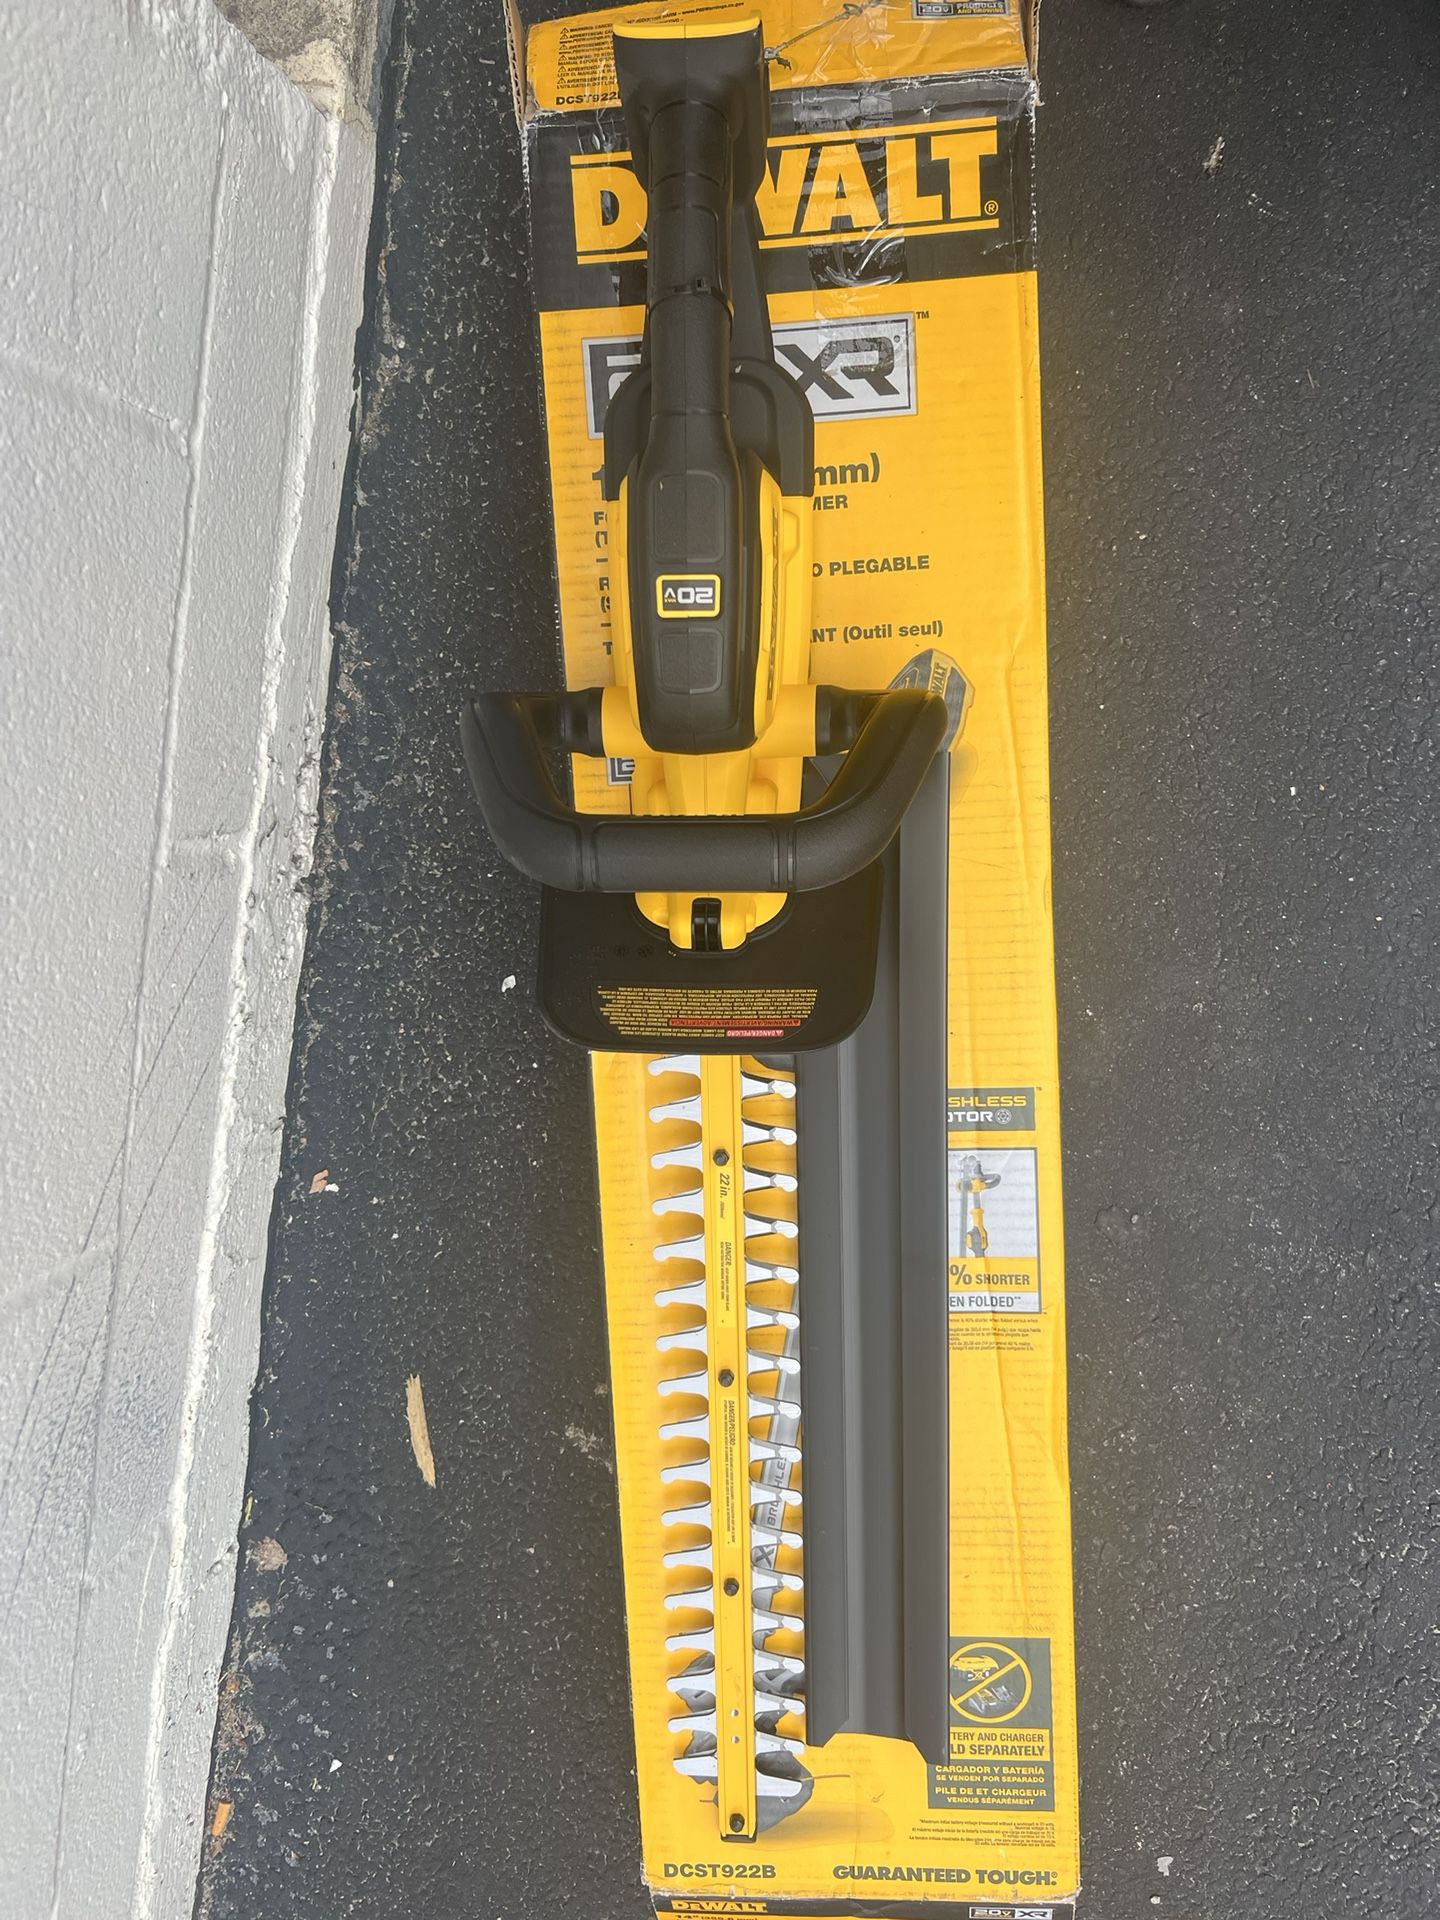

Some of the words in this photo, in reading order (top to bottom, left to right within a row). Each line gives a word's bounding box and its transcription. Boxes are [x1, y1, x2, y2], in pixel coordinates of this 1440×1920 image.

[556, 92, 620, 105] DCST922
[571, 127, 999, 253] DWALT
[774, 336, 900, 400] XR
[829, 555, 930, 577] PLEGABLE
[842, 624, 892, 643] (Outil
[898, 620, 943, 638] seul)
[948, 1095, 1027, 1108] SHLESS
[948, 1111, 993, 1123] TOR
[719, 1173, 731, 1186] 22
[975, 1274, 1030, 1286] SHORTER
[949, 1296, 965, 1308] EN
[951, 1732, 975, 1741] TERY
[977, 1732, 997, 1742] AND
[1000, 1733, 1044, 1742] CHARGER
[950, 1743, 966, 1755] LD
[969, 1744, 1045, 1757] SEPARATELY
[935, 1765, 991, 1774] CARGADOR
[993, 1766, 1000, 1774] Y
[1002, 1765, 1045, 1775] BATERÍA
[947, 1774, 980, 1782] VENDEN
[982, 1775, 1000, 1783] POR
[935, 1786, 957, 1795] PILE
[959, 1787, 973, 1795] DE
[991, 1788, 1047, 1797] CHARGEUR
[947, 1796, 979, 1804] VENDUS
[664, 1863, 777, 1879] DCST922B
[833, 1865, 971, 1883] GUARANTEED
